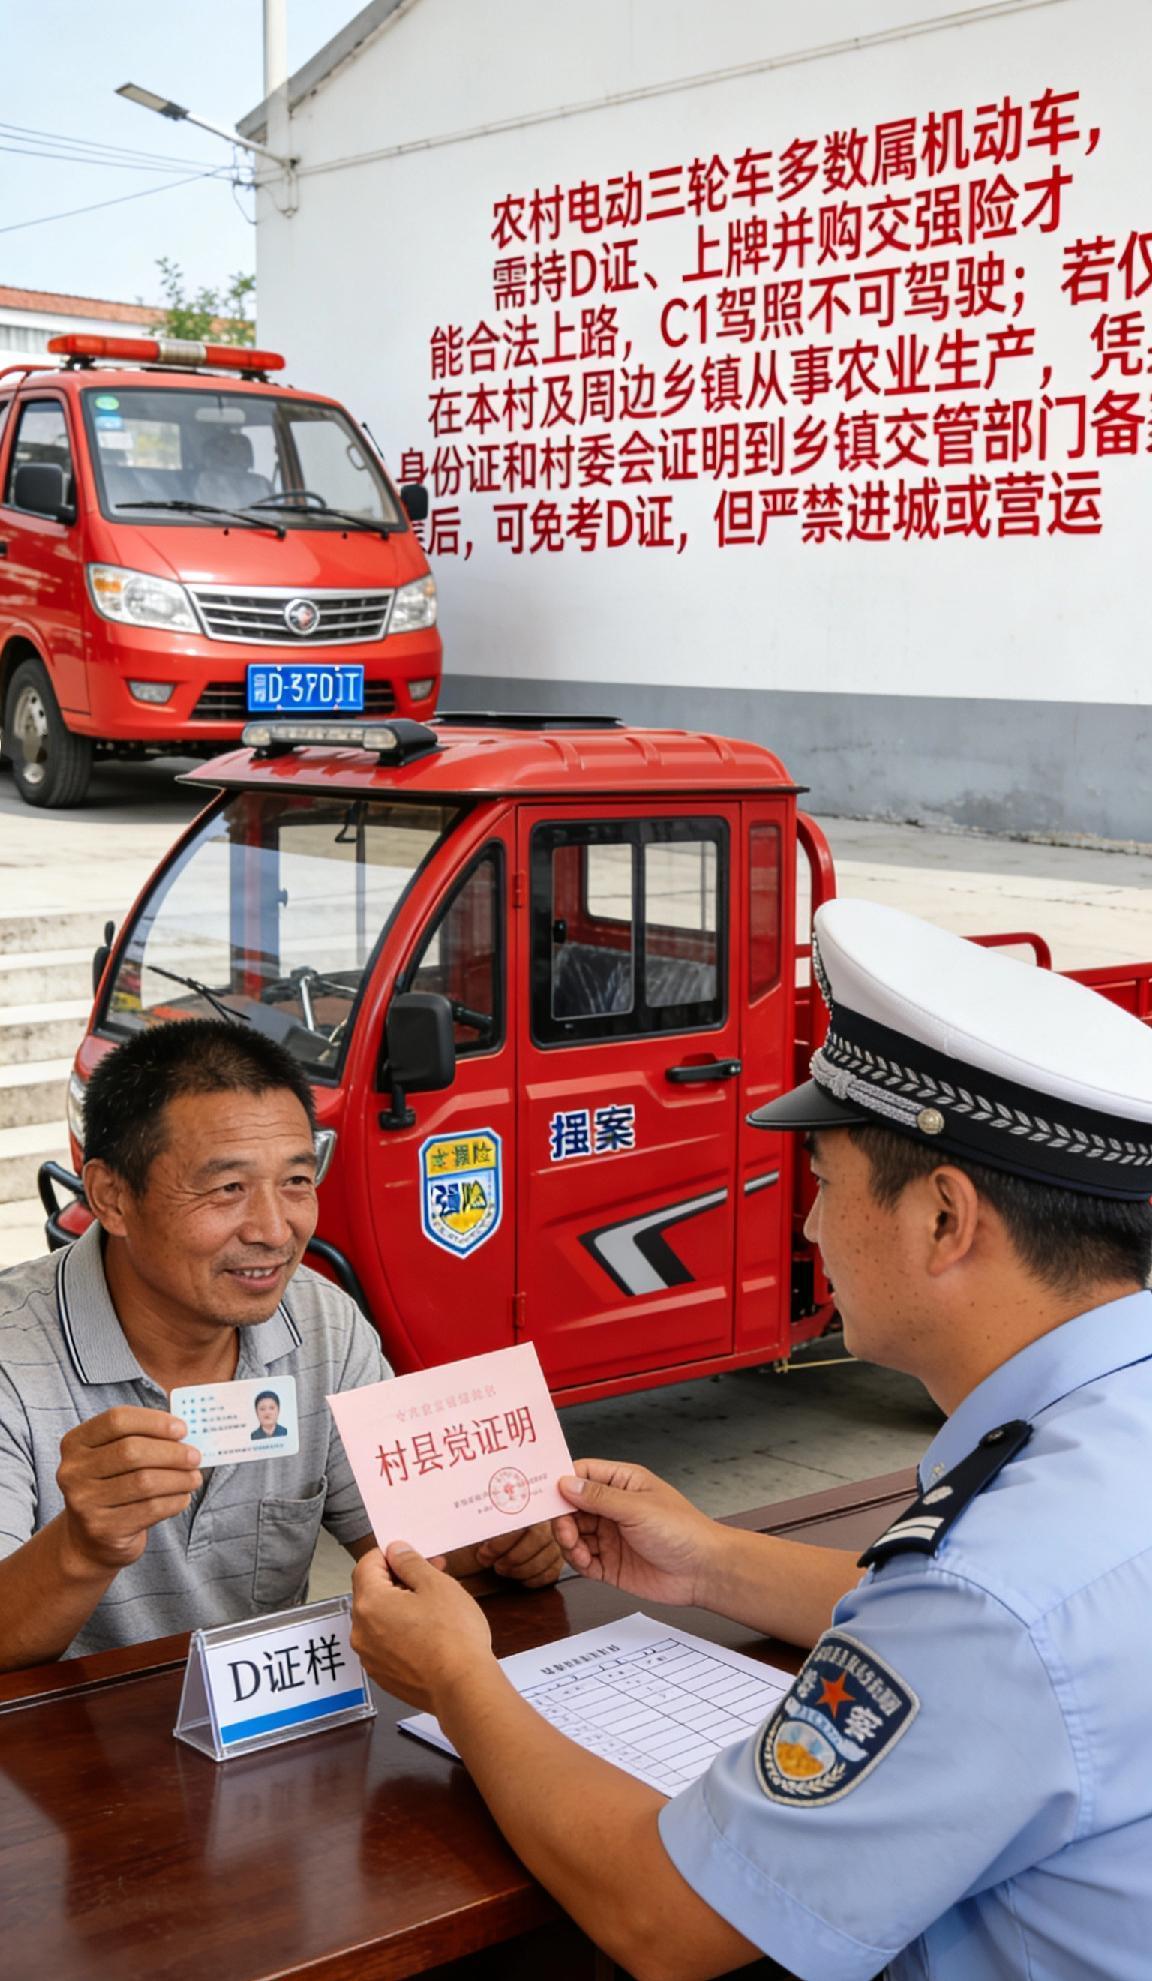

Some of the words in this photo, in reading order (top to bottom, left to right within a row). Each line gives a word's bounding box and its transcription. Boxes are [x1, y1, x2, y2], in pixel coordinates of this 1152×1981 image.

[491, 88, 1101, 250] 农村电动三轮车多数属机动车，
[493, 164, 1073, 311] 需持D证、上牌并购交强险才
[428, 310, 1152, 438] 在本村及周边乡镇从事农业生产，凭
[396, 388, 1152, 498] 身份证和村委会证明到乡镇交管部门备
[411, 470, 1103, 561] 后，可免考D证，但严禁进城或营运
[227, 1633, 346, 1703] D证样
